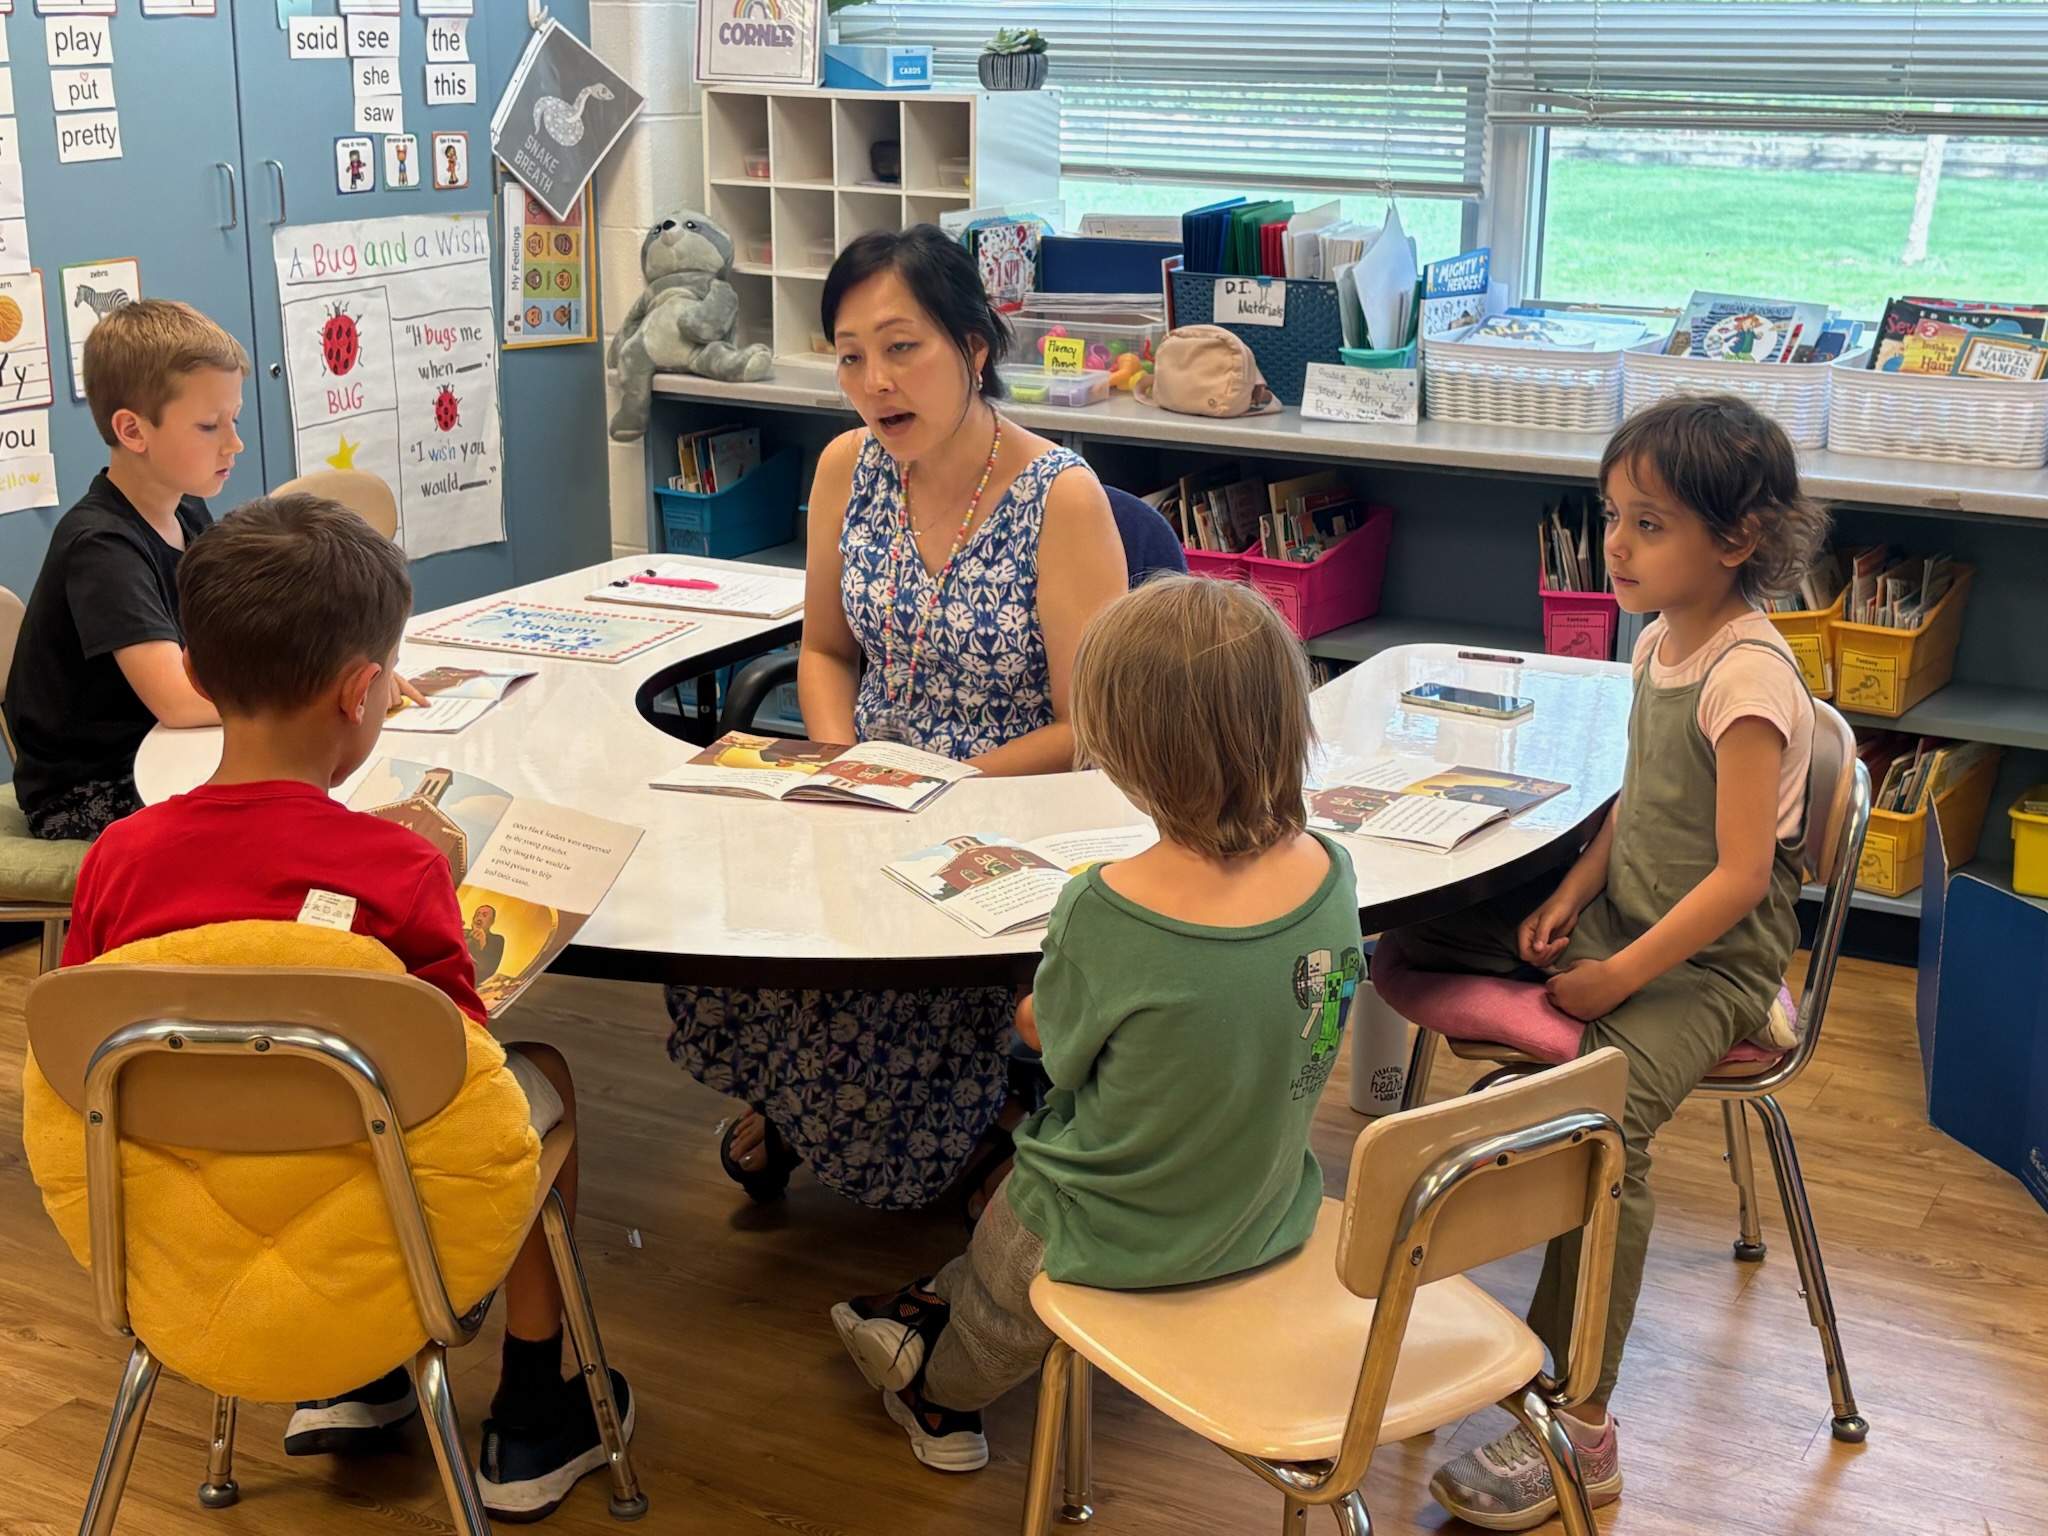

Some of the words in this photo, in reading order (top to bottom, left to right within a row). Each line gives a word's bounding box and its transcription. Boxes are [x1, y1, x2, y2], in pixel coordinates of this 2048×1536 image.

[55, 25, 102, 57] play
[296, 26, 338, 50] said
[357, 29, 389, 48] see
[432, 27, 460, 51] the
[719, 22, 795, 48] CORNER
[362, 66, 390, 86] she
[899, 66, 921, 75] CARDS
[68, 80, 99, 105] put
[434, 73, 466, 96] this
[364, 104, 394, 122] saw
[62, 123, 117, 152] pretty
[525, 133, 560, 175] SNAKE
[514, 149, 554, 195] BREATH
[290, 247, 304, 279] A
[313, 242, 358, 277] Bug
[363, 231, 407, 268] and
[413, 235, 429, 258] a
[435, 219, 486, 257] Wish
[511, 225, 522, 274] Feelings
[90, 269, 109, 279] zebra
[1438, 257, 1477, 283] MIGHTY
[1447, 268, 1485, 292] HEROES!
[0, 281, 12, 289] arn
[511, 274, 521, 291] My
[1225, 280, 1252, 294] D.I.
[1886, 312, 1917, 335] Sev
[1919, 310, 1938, 320] ED
[424, 323, 458, 352] bugs
[460, 325, 483, 342] me
[1924, 325, 1937, 337] 2
[1978, 348, 2033, 368] MARVIN
[1981, 360, 2027, 378] JAMES
[327, 381, 364, 415] BUG
[428, 442, 456, 462] wish
[460, 440, 486, 463] you
[0, 471, 41, 491] ellow
[1567, 616, 1590, 624] Fantasy
[1856, 656, 1878, 667] Fantasy
